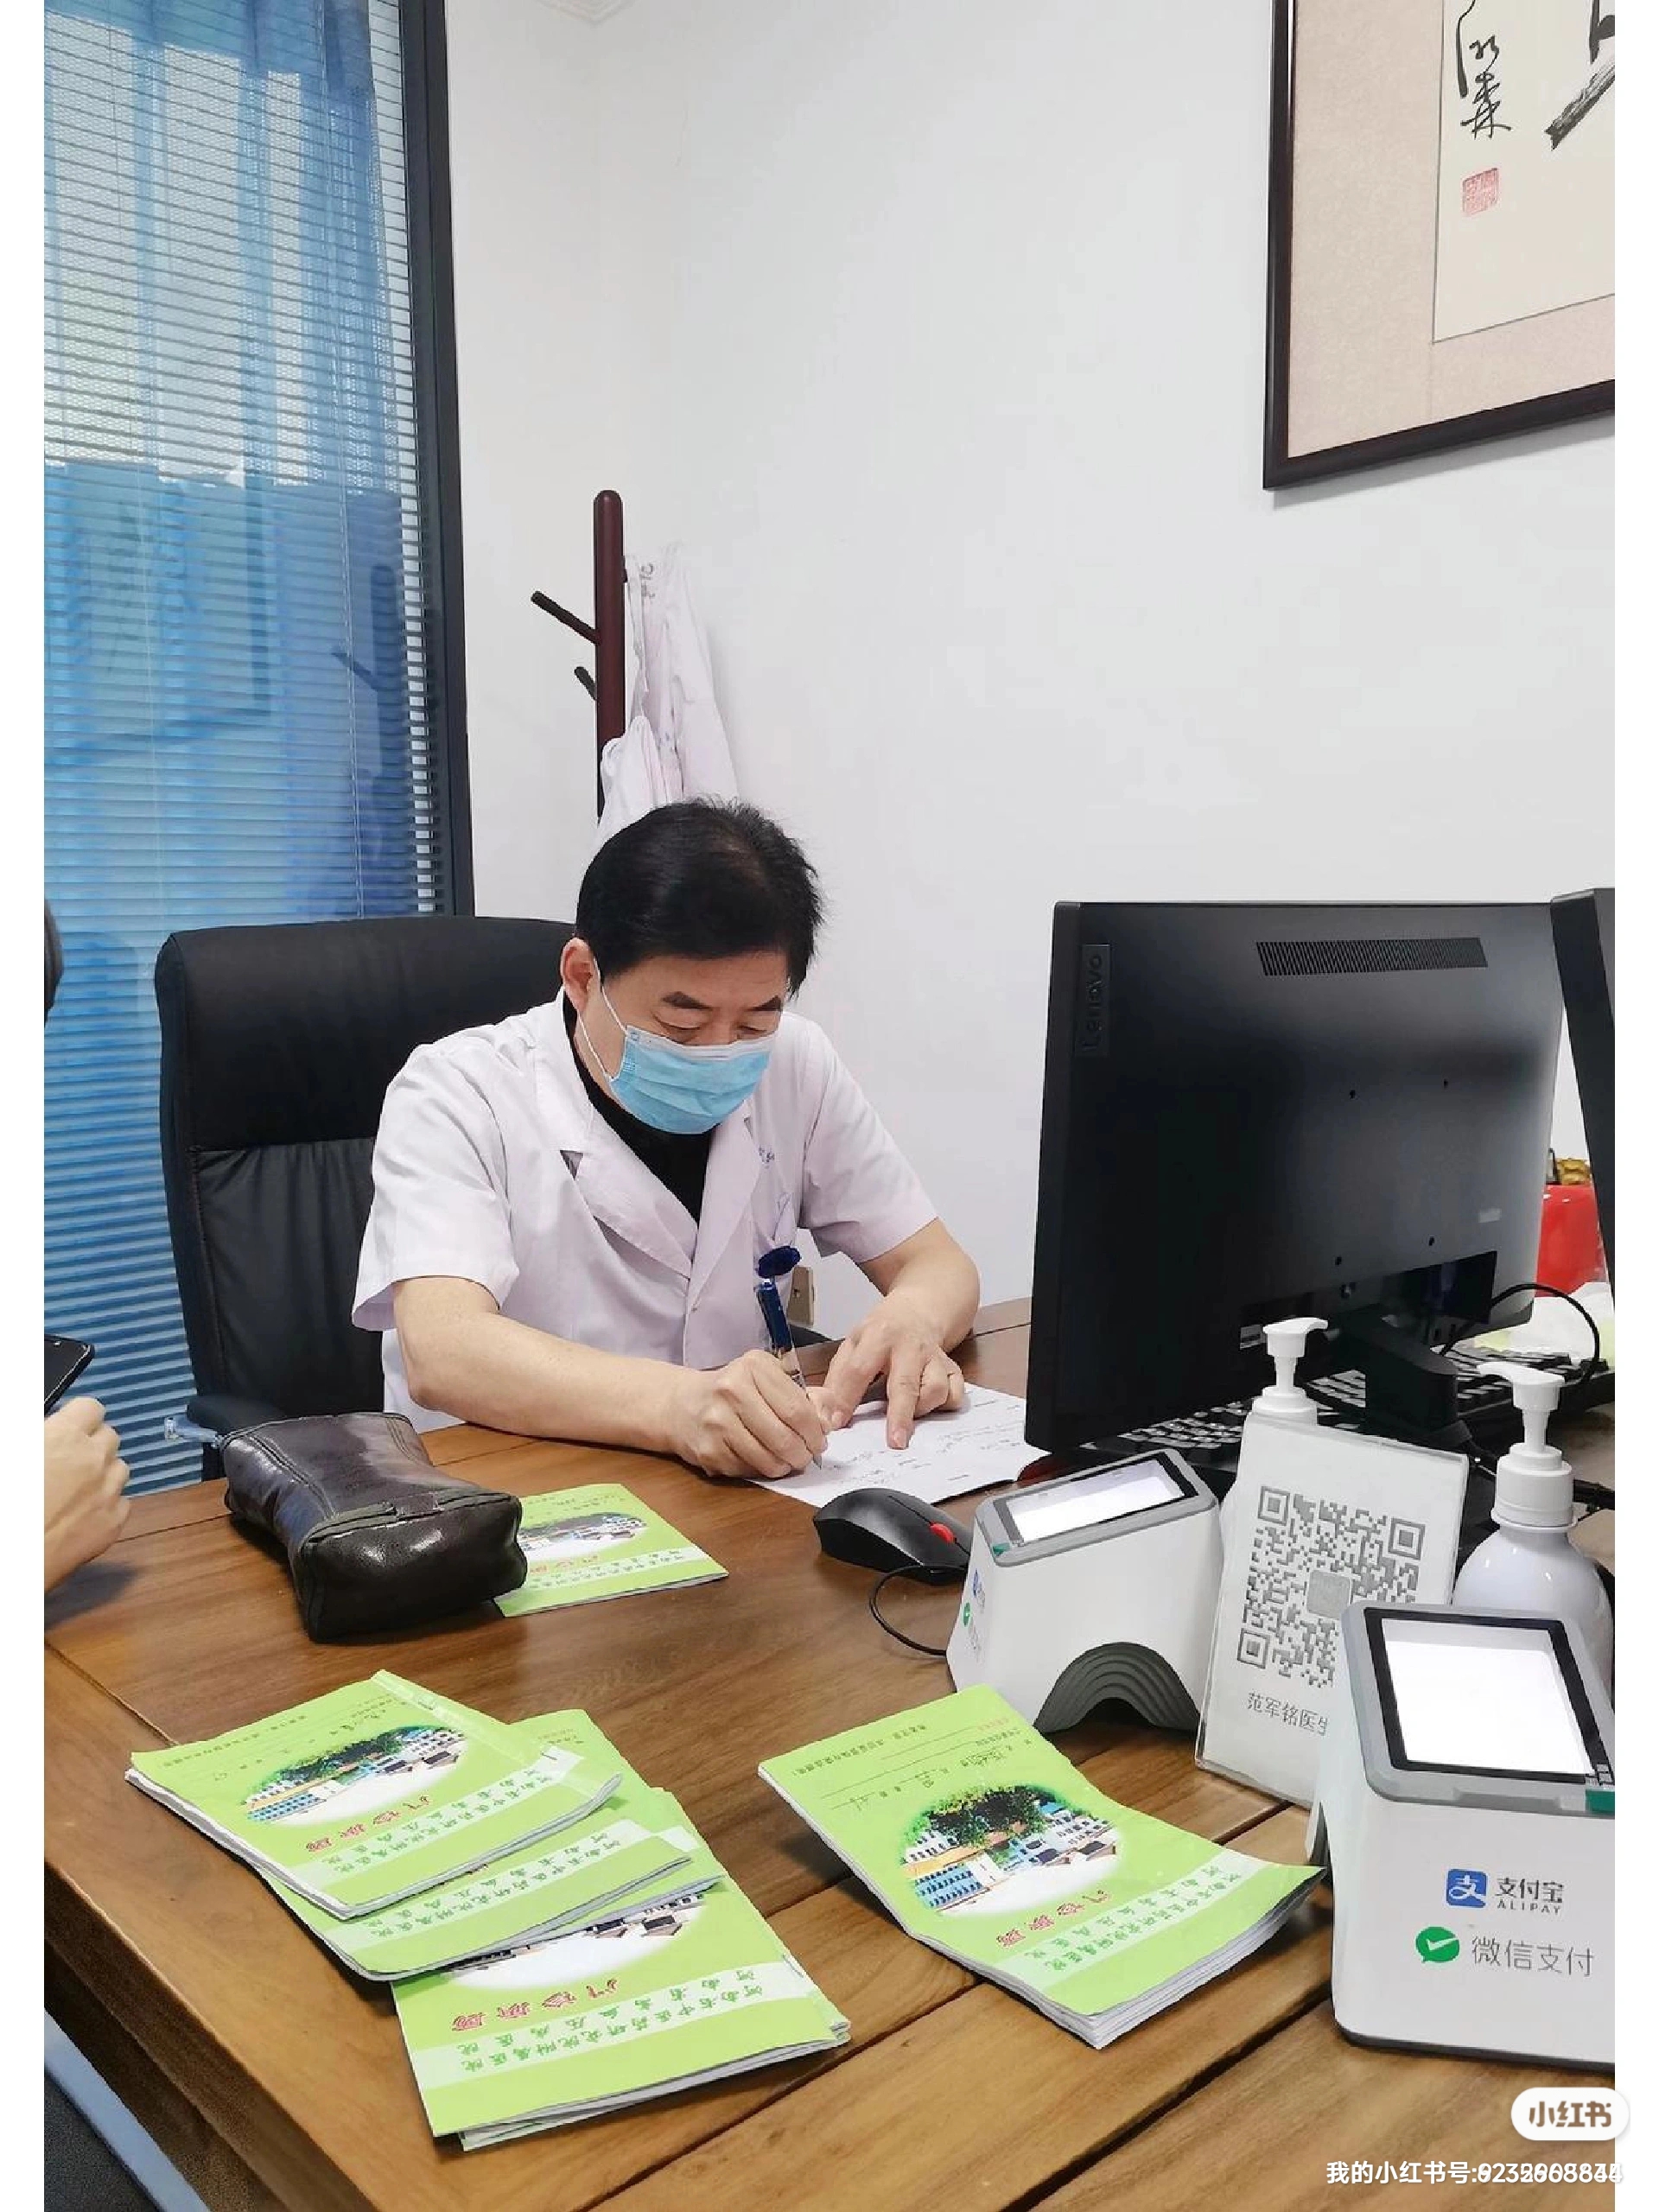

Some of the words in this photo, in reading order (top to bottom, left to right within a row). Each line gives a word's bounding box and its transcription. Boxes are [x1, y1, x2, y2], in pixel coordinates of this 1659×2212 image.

[1495, 1877, 1563, 1903] 支付宝
[1497, 1898, 1560, 1914] ALIPAY
[1471, 1936, 1595, 1977] 微信支付
